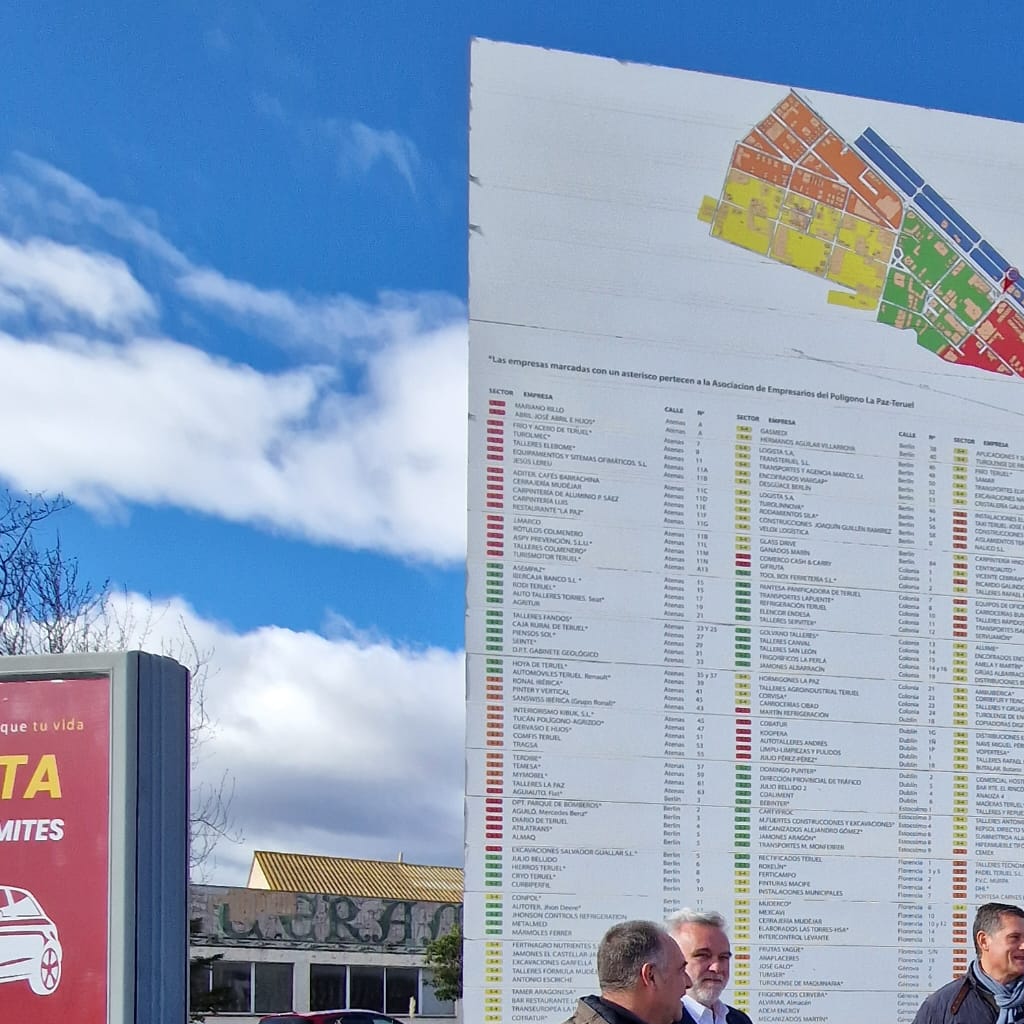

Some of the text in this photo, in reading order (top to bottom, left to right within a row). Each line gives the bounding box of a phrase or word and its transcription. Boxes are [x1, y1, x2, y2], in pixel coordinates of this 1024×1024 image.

[508, 359, 548, 368] empresas
[550, 363, 590, 373] marcadas
[621, 371, 657, 381] asterisco
[659, 375, 695, 385] pertecen
[703, 378, 710, 386] la
[712, 380, 754, 391] Asociacion
[756, 385, 766, 393] de
[768, 386, 815, 399] Empresarios
[817, 391, 829, 399] del
[866, 396, 875, 404] La
[524, 392, 553, 400] EMPRESA
[0, 719, 84, 735] que tu vida
[0, 754, 62, 799] TA
